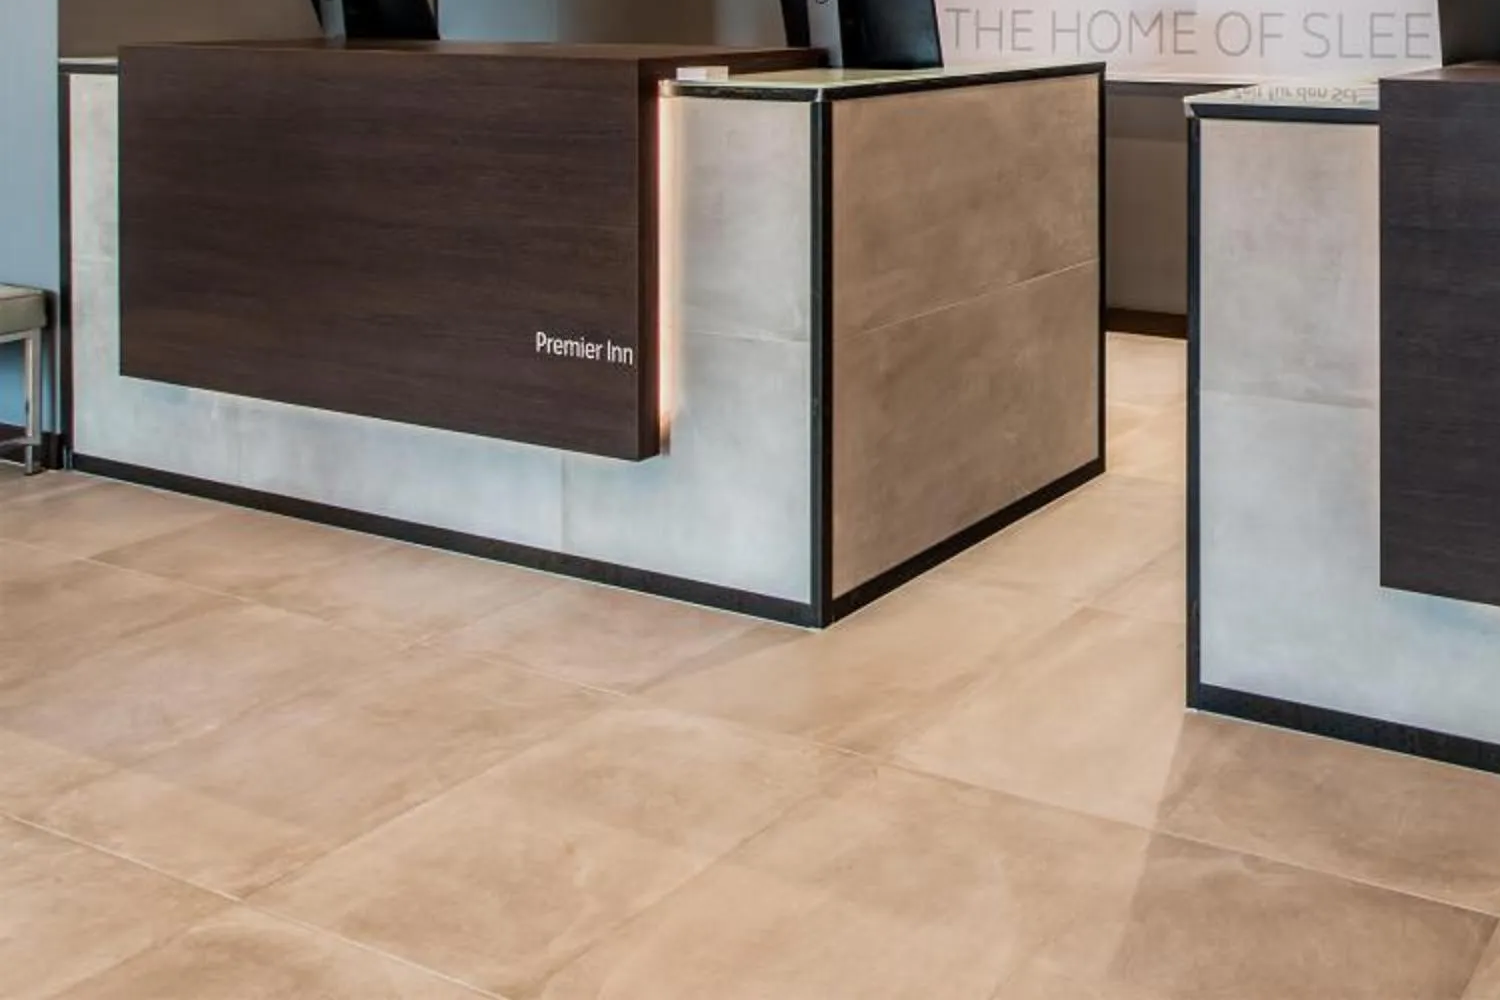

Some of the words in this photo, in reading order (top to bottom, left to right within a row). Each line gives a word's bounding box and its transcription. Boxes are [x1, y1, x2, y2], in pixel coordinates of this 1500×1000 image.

[946, 7, 1034, 53] THE
[1051, 8, 1198, 56] HOME
[1214, 10, 1285, 58] OF
[1303, 11, 1433, 59] SLEE
[536, 331, 603, 361] Premier
[607, 339, 633, 365] Inn
